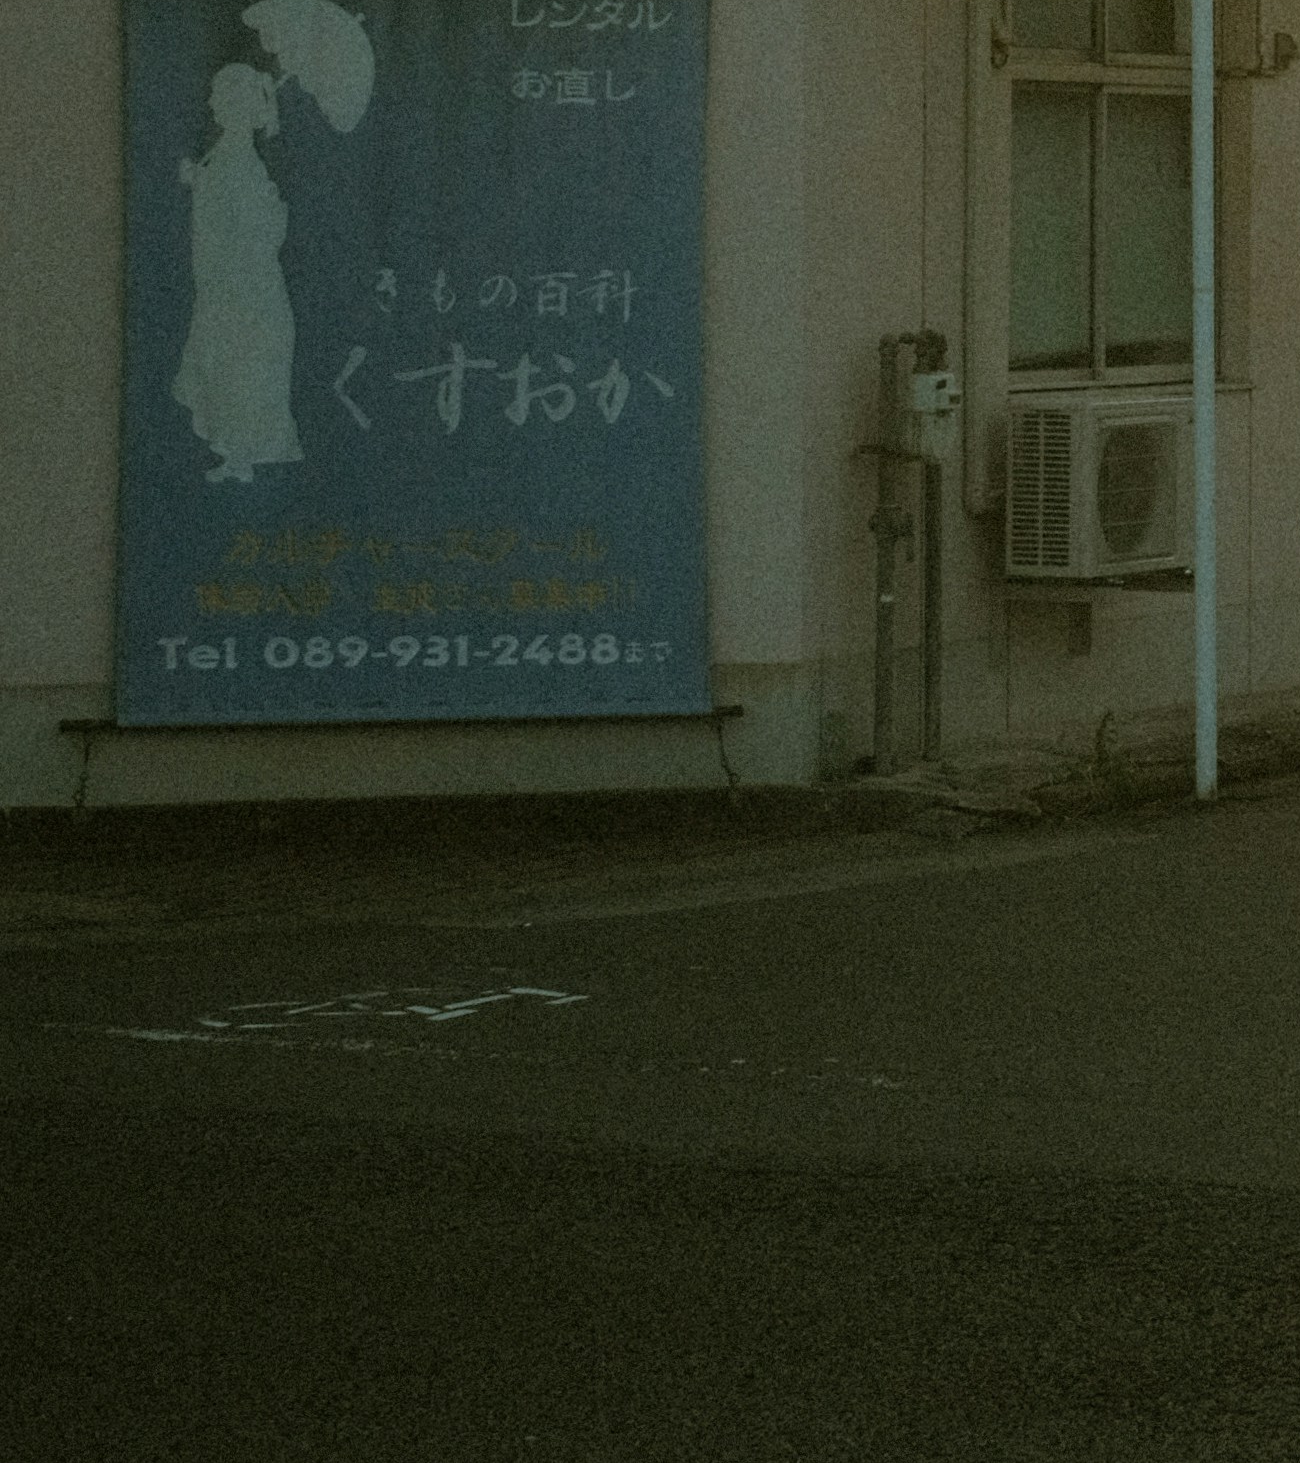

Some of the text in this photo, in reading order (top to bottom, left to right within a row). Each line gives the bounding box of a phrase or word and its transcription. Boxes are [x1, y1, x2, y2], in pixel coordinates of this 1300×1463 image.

[512, 67, 638, 109] お直し
[375, 266, 639, 324] きもの百科
[333, 342, 676, 434] くすおか
[157, 635, 239, 671] Tel
